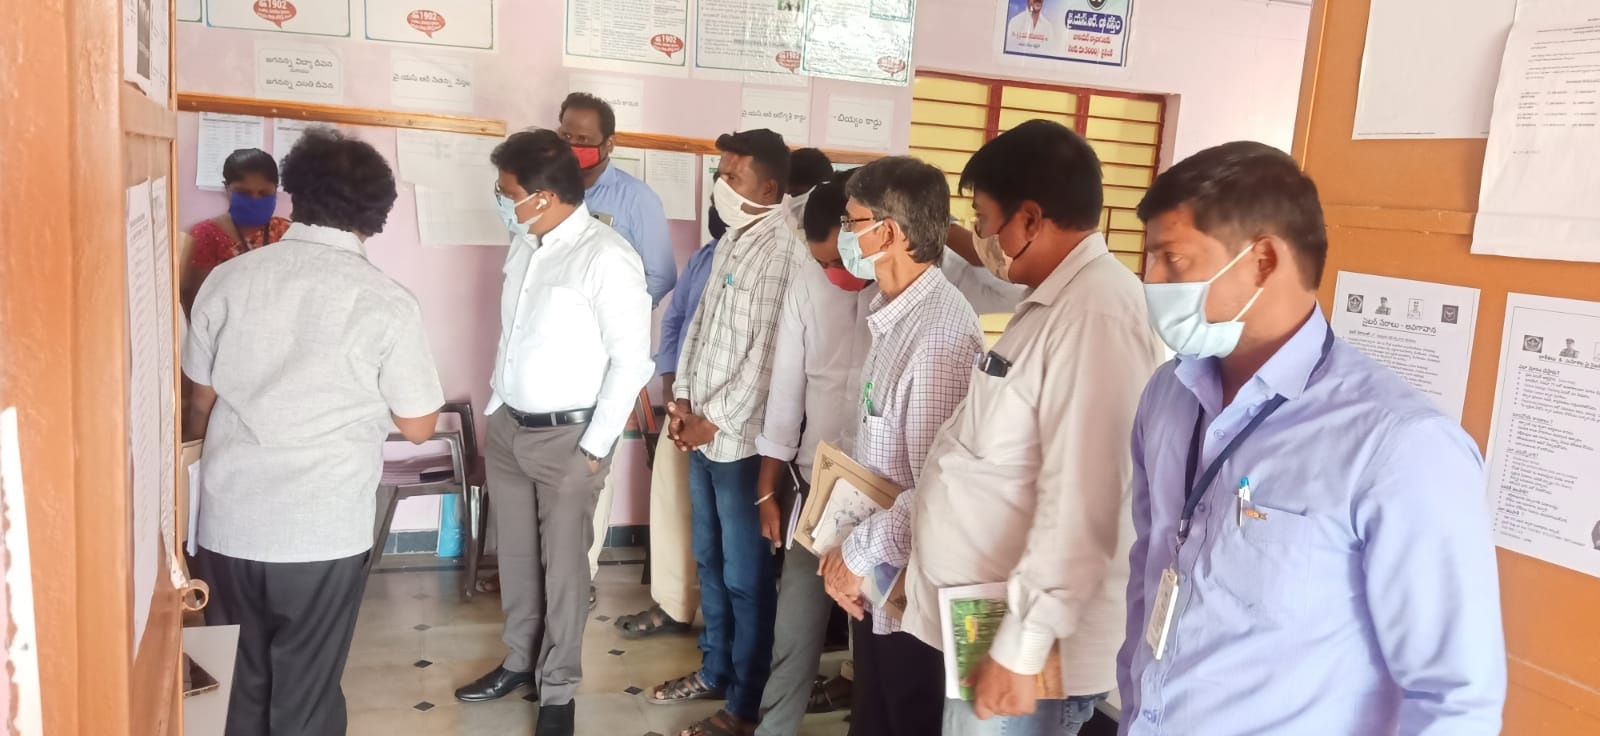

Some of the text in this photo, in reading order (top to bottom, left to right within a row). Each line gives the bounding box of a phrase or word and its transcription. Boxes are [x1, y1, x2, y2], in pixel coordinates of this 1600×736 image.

[265, 57, 293, 67] జగనన్న
[265, 79, 294, 89] జగనన్న
[837, 113, 882, 130] బియ్యం కార్డు
